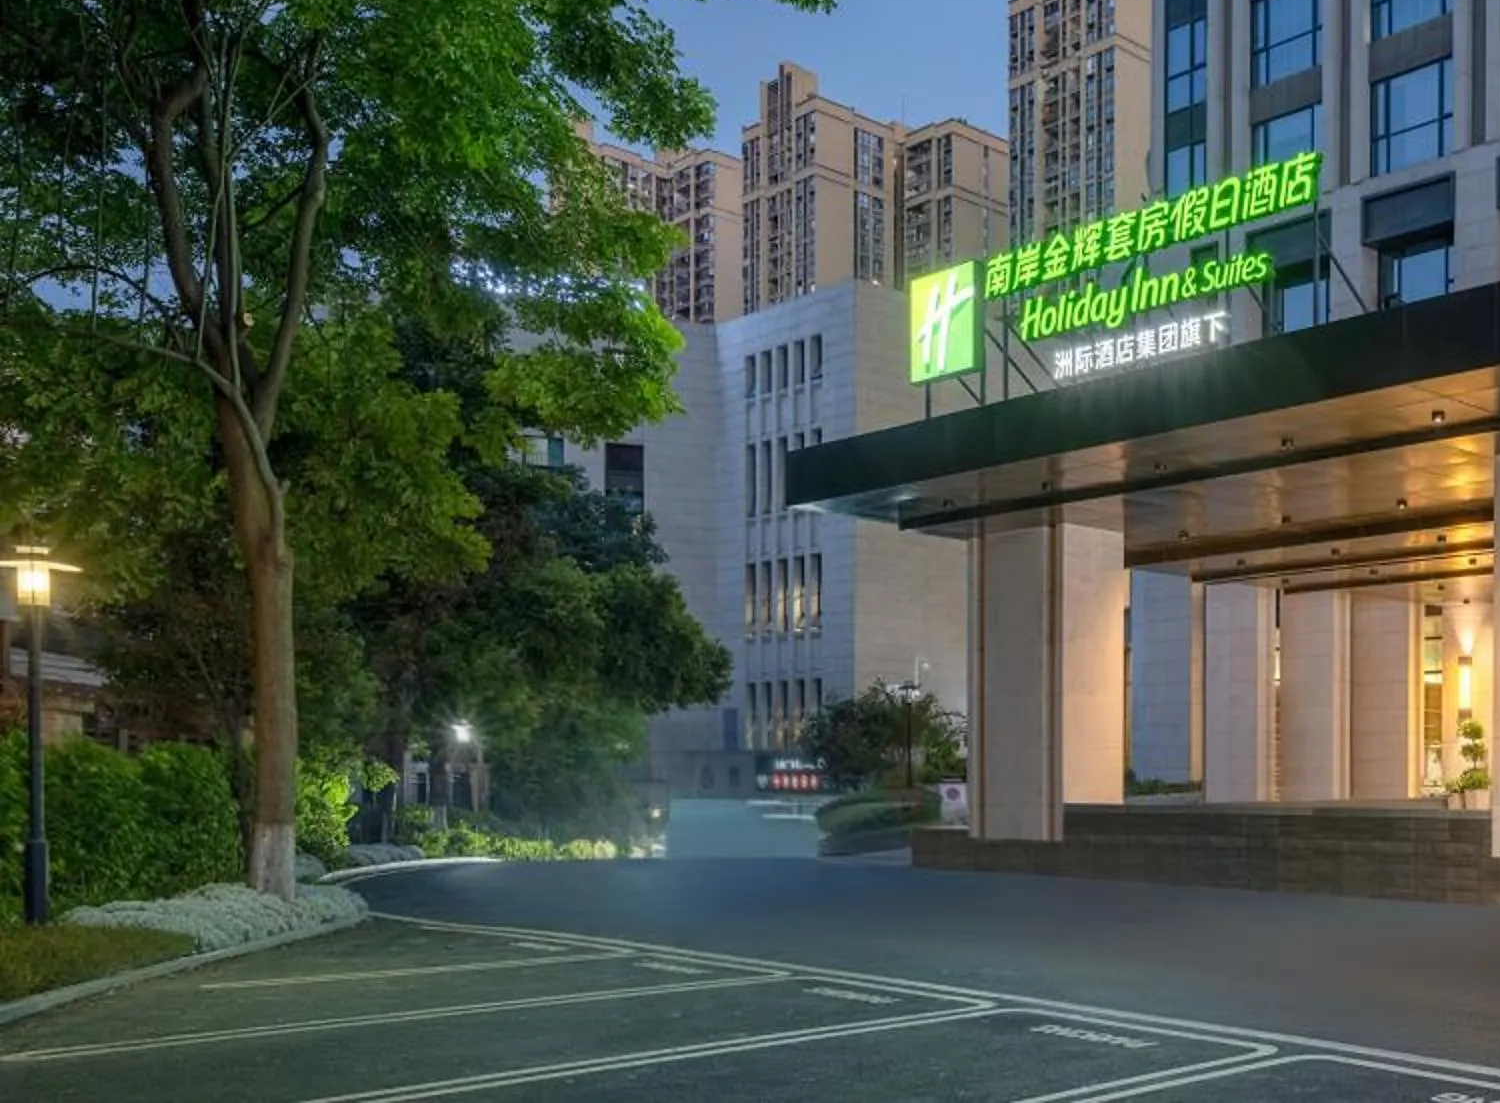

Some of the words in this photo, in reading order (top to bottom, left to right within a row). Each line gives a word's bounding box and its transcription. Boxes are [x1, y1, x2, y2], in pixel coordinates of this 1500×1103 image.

[985, 151, 1318, 297] 南岸金辉套房假日酒店
[1020, 281, 1128, 339] Holiday
[1131, 267, 1180, 312] Inn
[1181, 269, 1198, 297] &
[1200, 252, 1269, 294] Suites
[1053, 310, 1228, 378] 洲际酒店集团旗下
